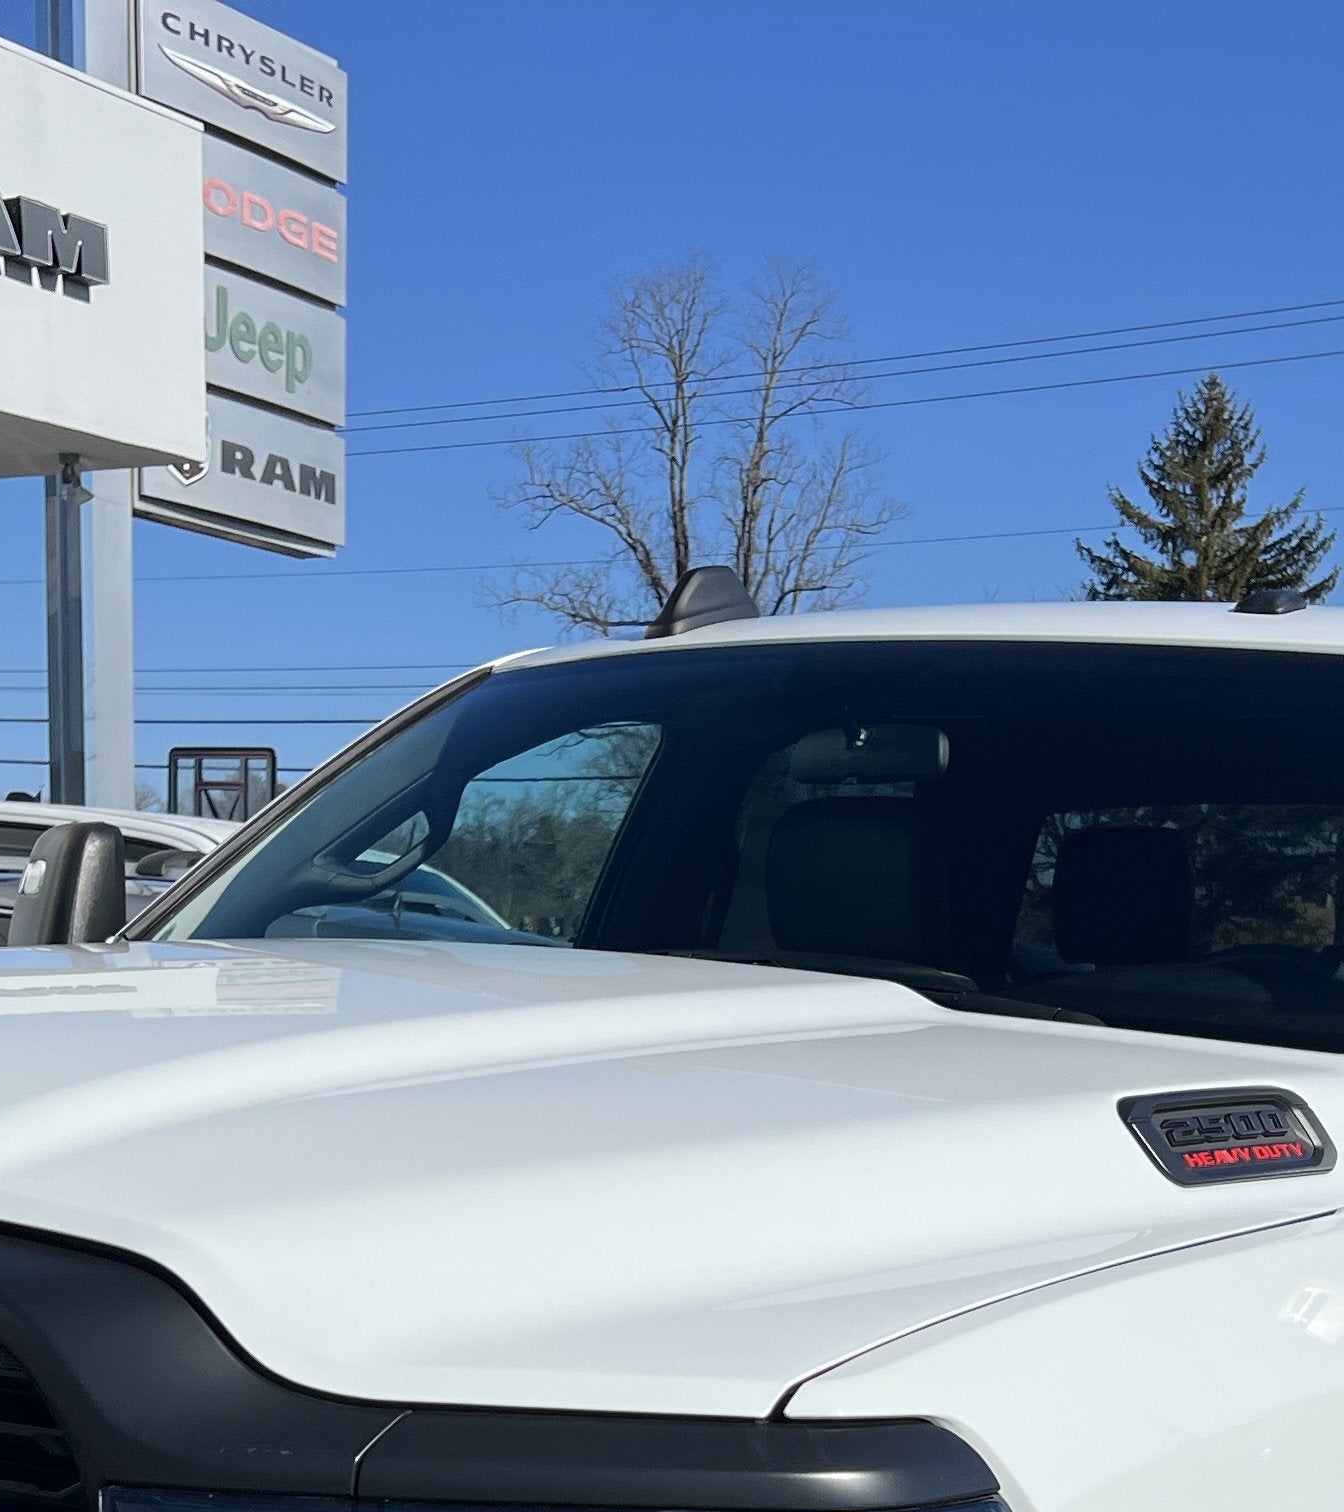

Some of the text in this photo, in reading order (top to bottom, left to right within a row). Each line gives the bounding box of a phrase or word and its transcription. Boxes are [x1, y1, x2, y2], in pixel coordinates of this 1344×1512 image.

[160, 11, 334, 108] CHRYSLER
[203, 178, 339, 264] ODGE
[205, 284, 313, 394] Jeep
[221, 440, 337, 505] RAM
[1159, 1110, 1291, 1148] 2500
[1183, 1142, 1305, 1169] HEAVY DUTY
